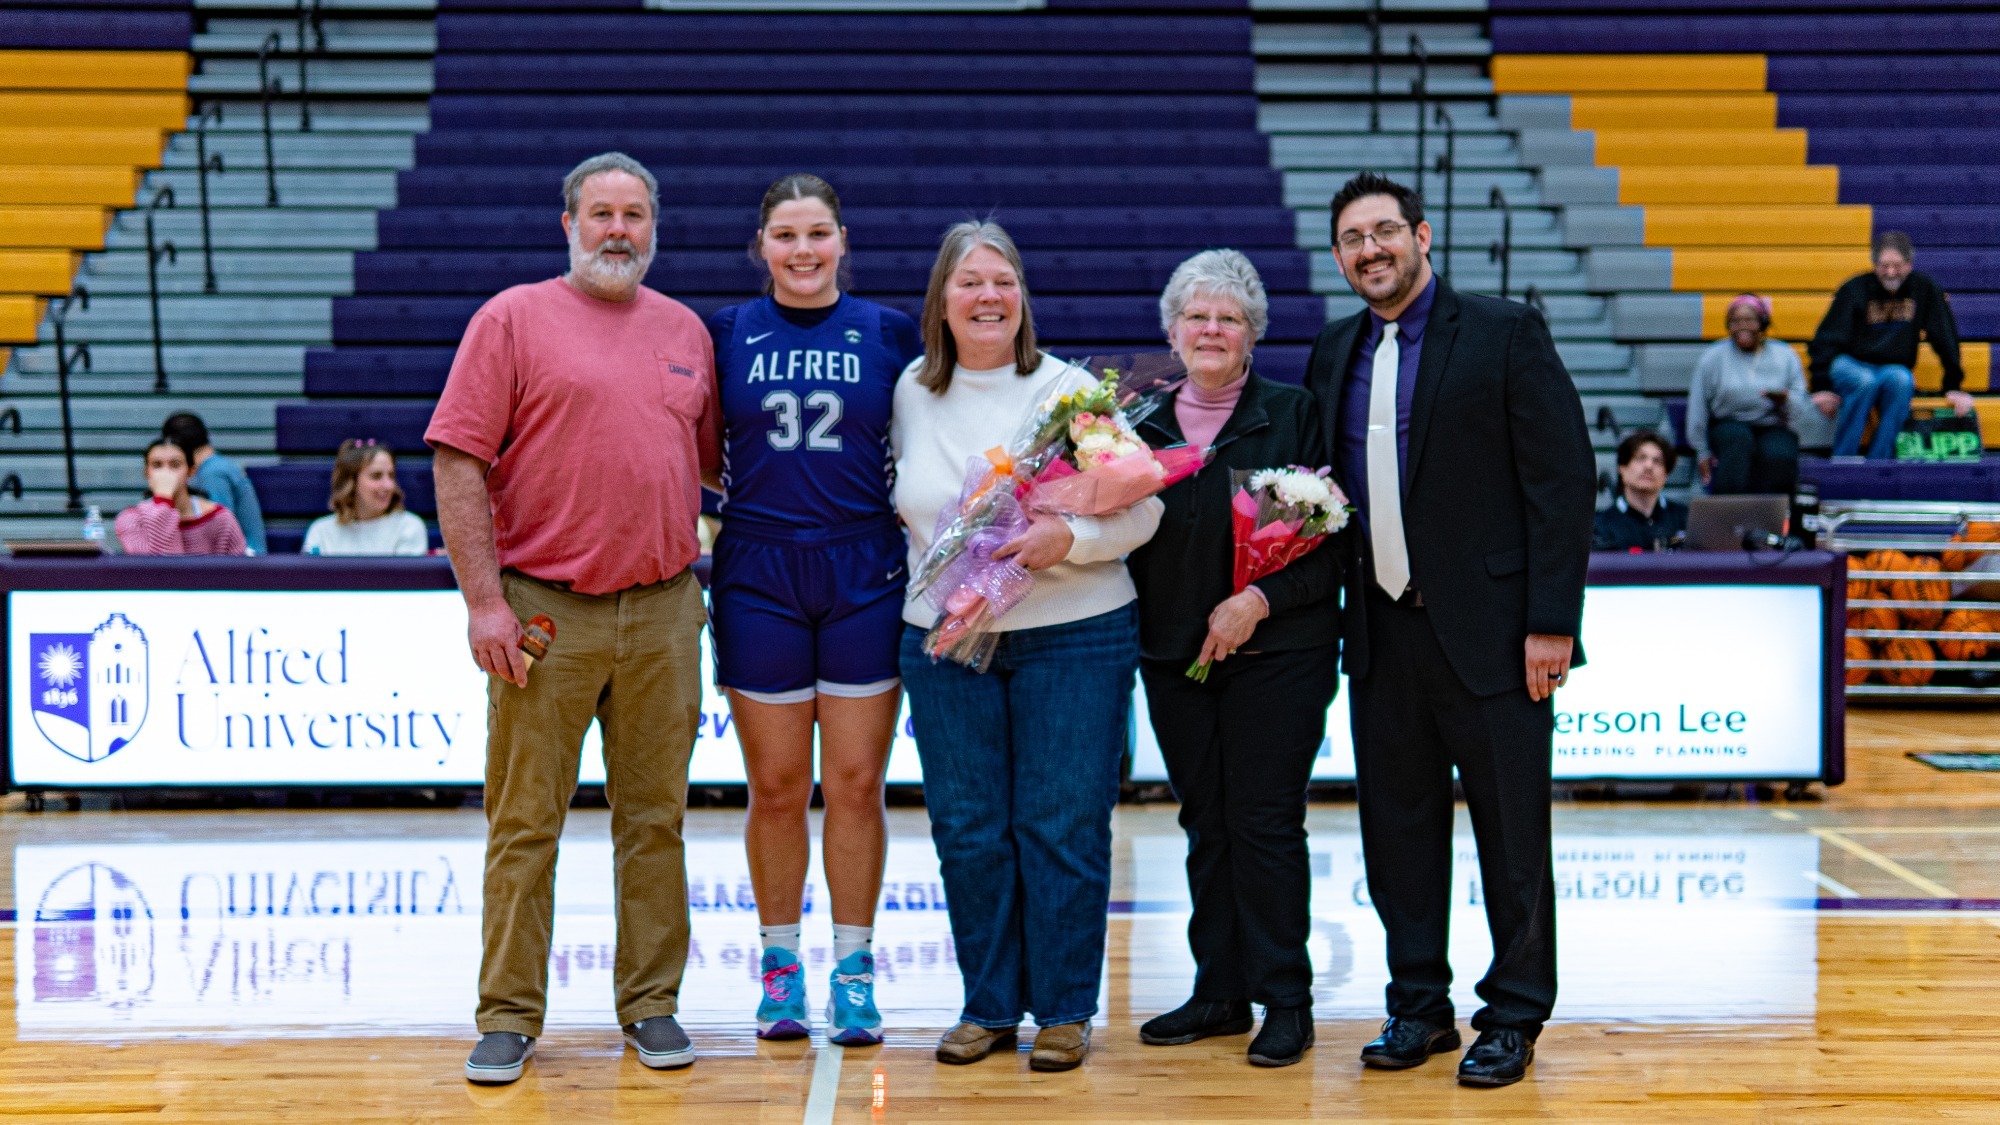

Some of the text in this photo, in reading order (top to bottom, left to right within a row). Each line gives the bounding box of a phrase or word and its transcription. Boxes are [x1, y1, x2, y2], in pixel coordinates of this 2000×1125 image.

[747, 350, 860, 384] ALFRED
[761, 389, 844, 452] 32
[175, 627, 348, 685] Alfred
[175, 691, 462, 766] University
[1553, 703, 1748, 734] erson Lee
[1557, 745, 1749, 757] NEERING PLANNING
